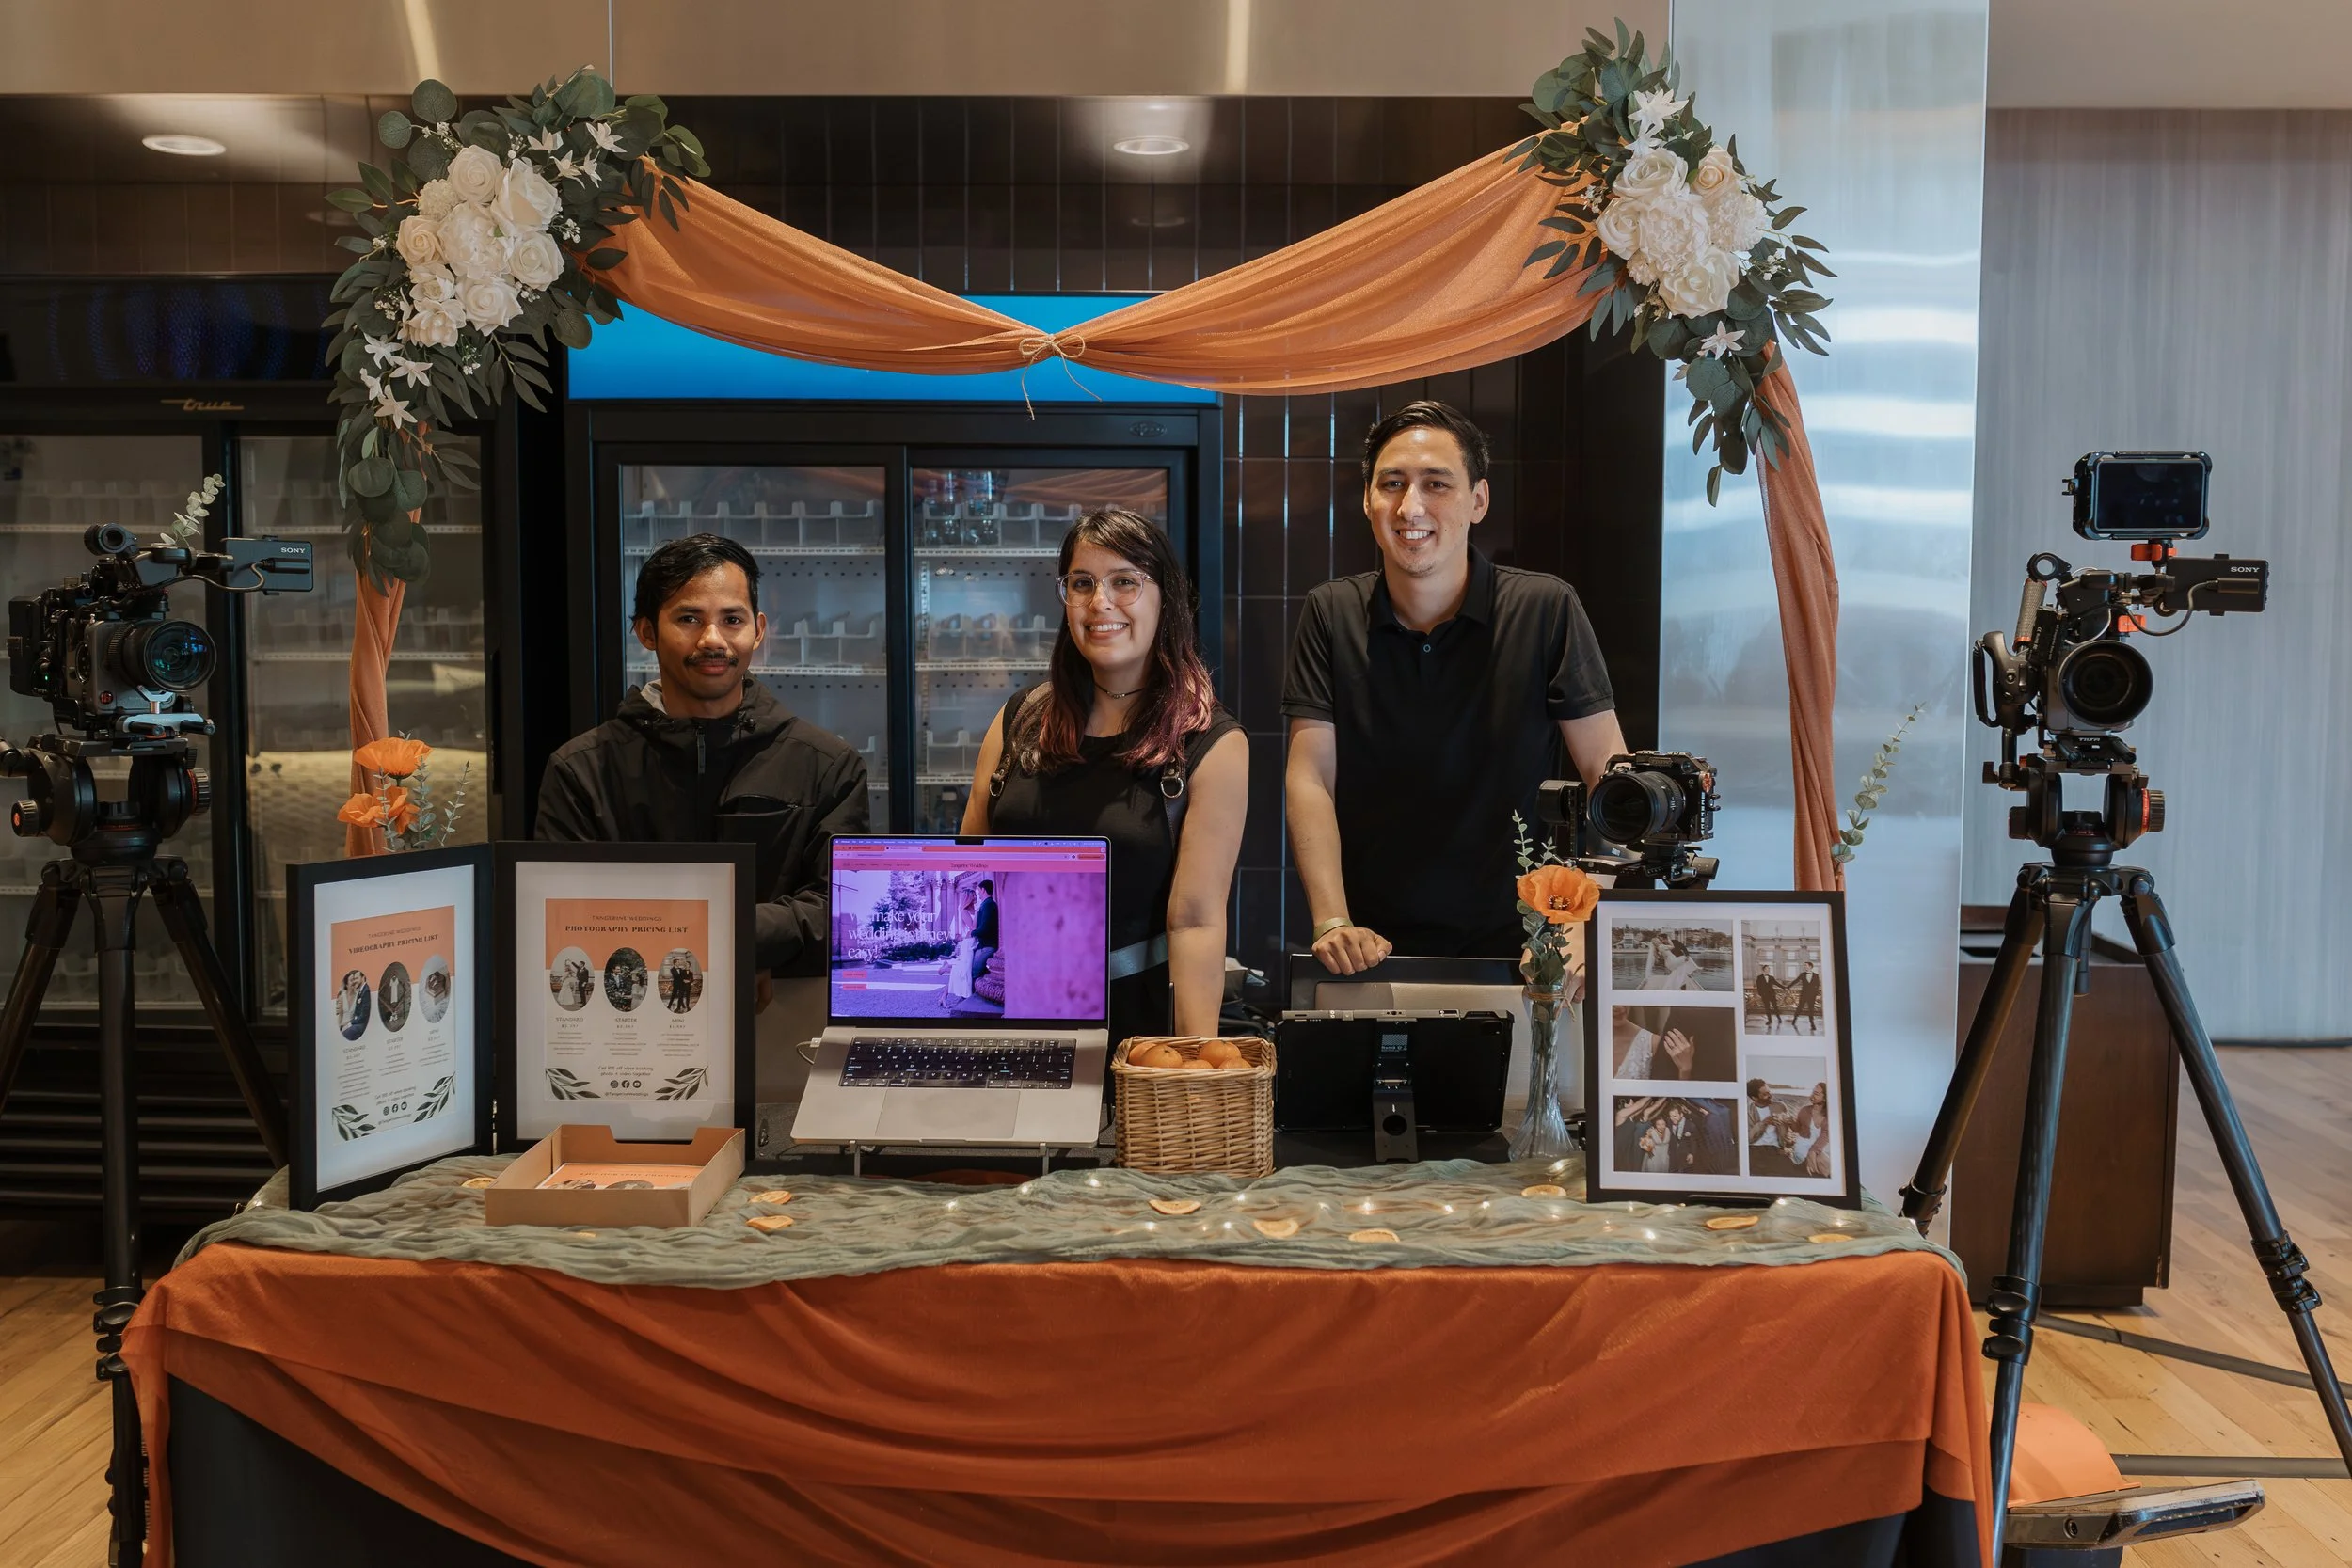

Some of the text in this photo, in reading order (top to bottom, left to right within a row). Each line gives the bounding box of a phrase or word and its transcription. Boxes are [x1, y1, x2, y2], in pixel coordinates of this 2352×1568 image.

[871, 910, 904, 923] make
[907, 912, 936, 925] your
[348, 934, 438, 955] VIDEOGRAPHY PRICING LIST
[848, 945, 879, 961] easy!
